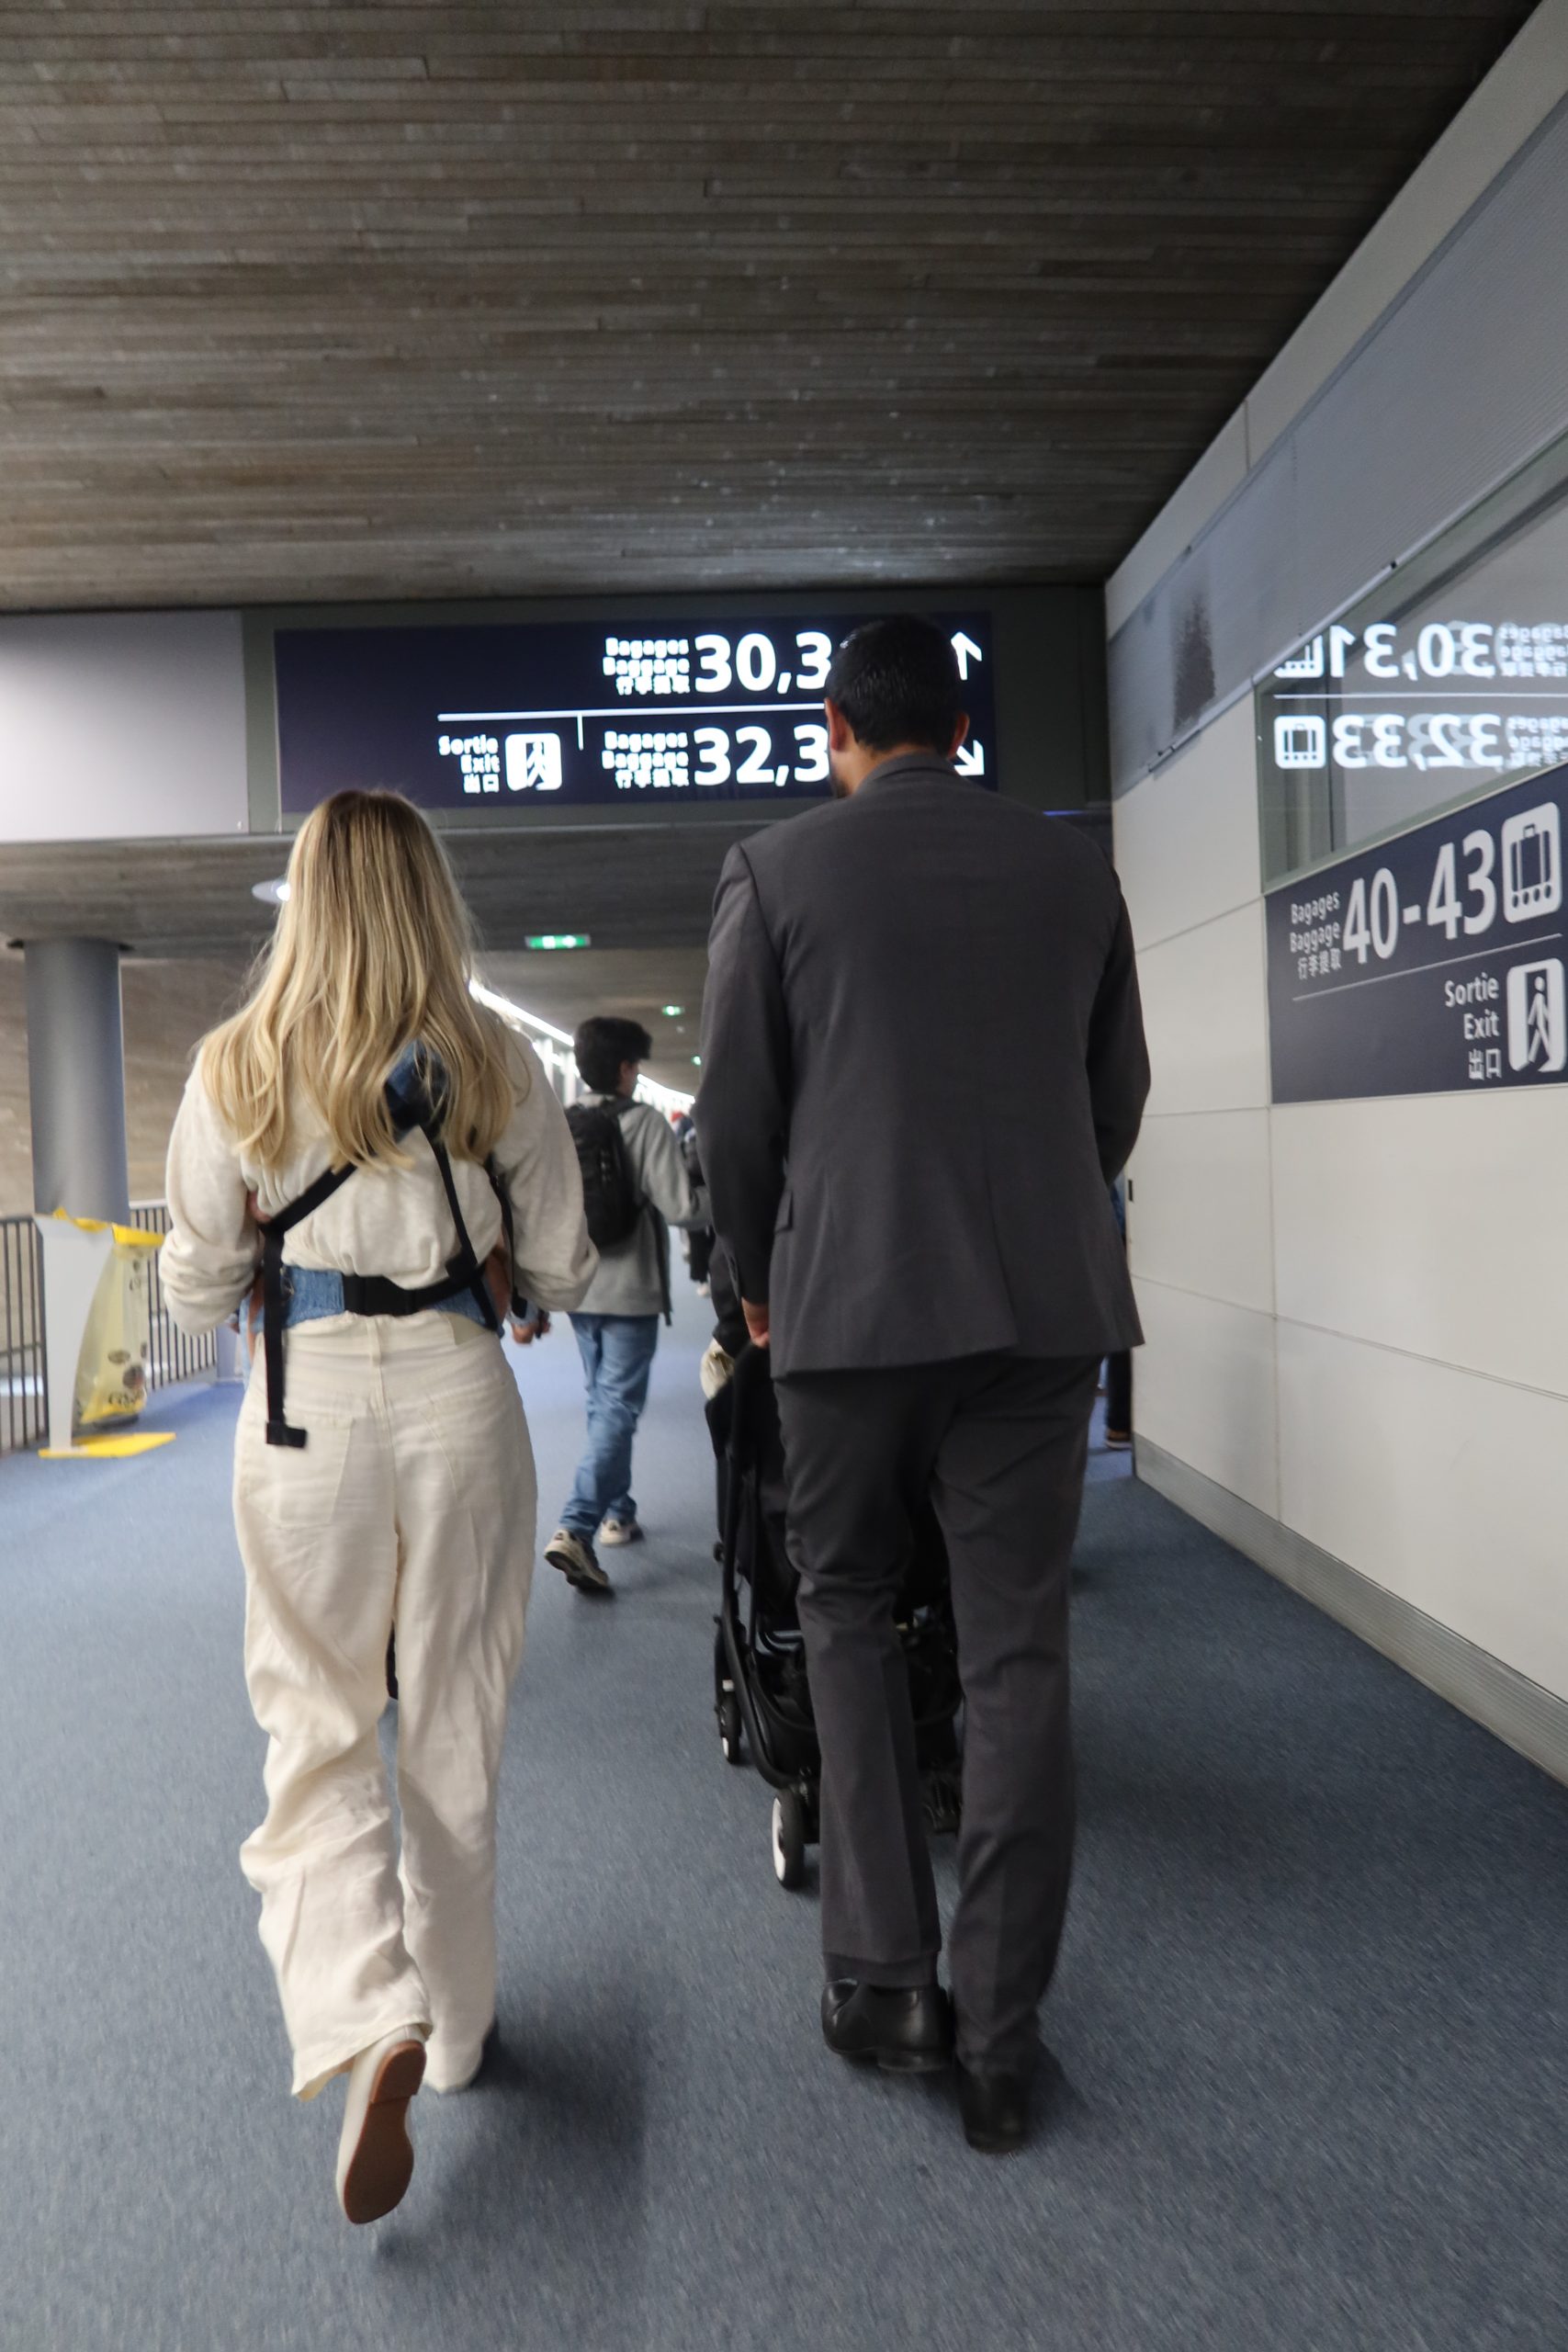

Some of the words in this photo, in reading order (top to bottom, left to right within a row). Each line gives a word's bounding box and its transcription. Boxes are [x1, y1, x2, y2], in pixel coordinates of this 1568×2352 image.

[605, 637, 689, 659] Bagages
[694, 631, 832, 695] 30,3
[603, 656, 690, 678] Baggage
[438, 734, 499, 756] Sortie
[604, 730, 688, 752] Bagages
[694, 724, 830, 786] 32,3
[460, 752, 501, 774] Exit
[602, 751, 689, 771] Baggage
[1291, 890, 1340, 925] Bagages
[1343, 829, 1497, 965] 40-43
[1290, 922, 1340, 954] Baggage
[1445, 971, 1499, 1008] Sortie
[1463, 1009, 1500, 1040] Exit
[1468, 1048, 1502, 1080] 出口
